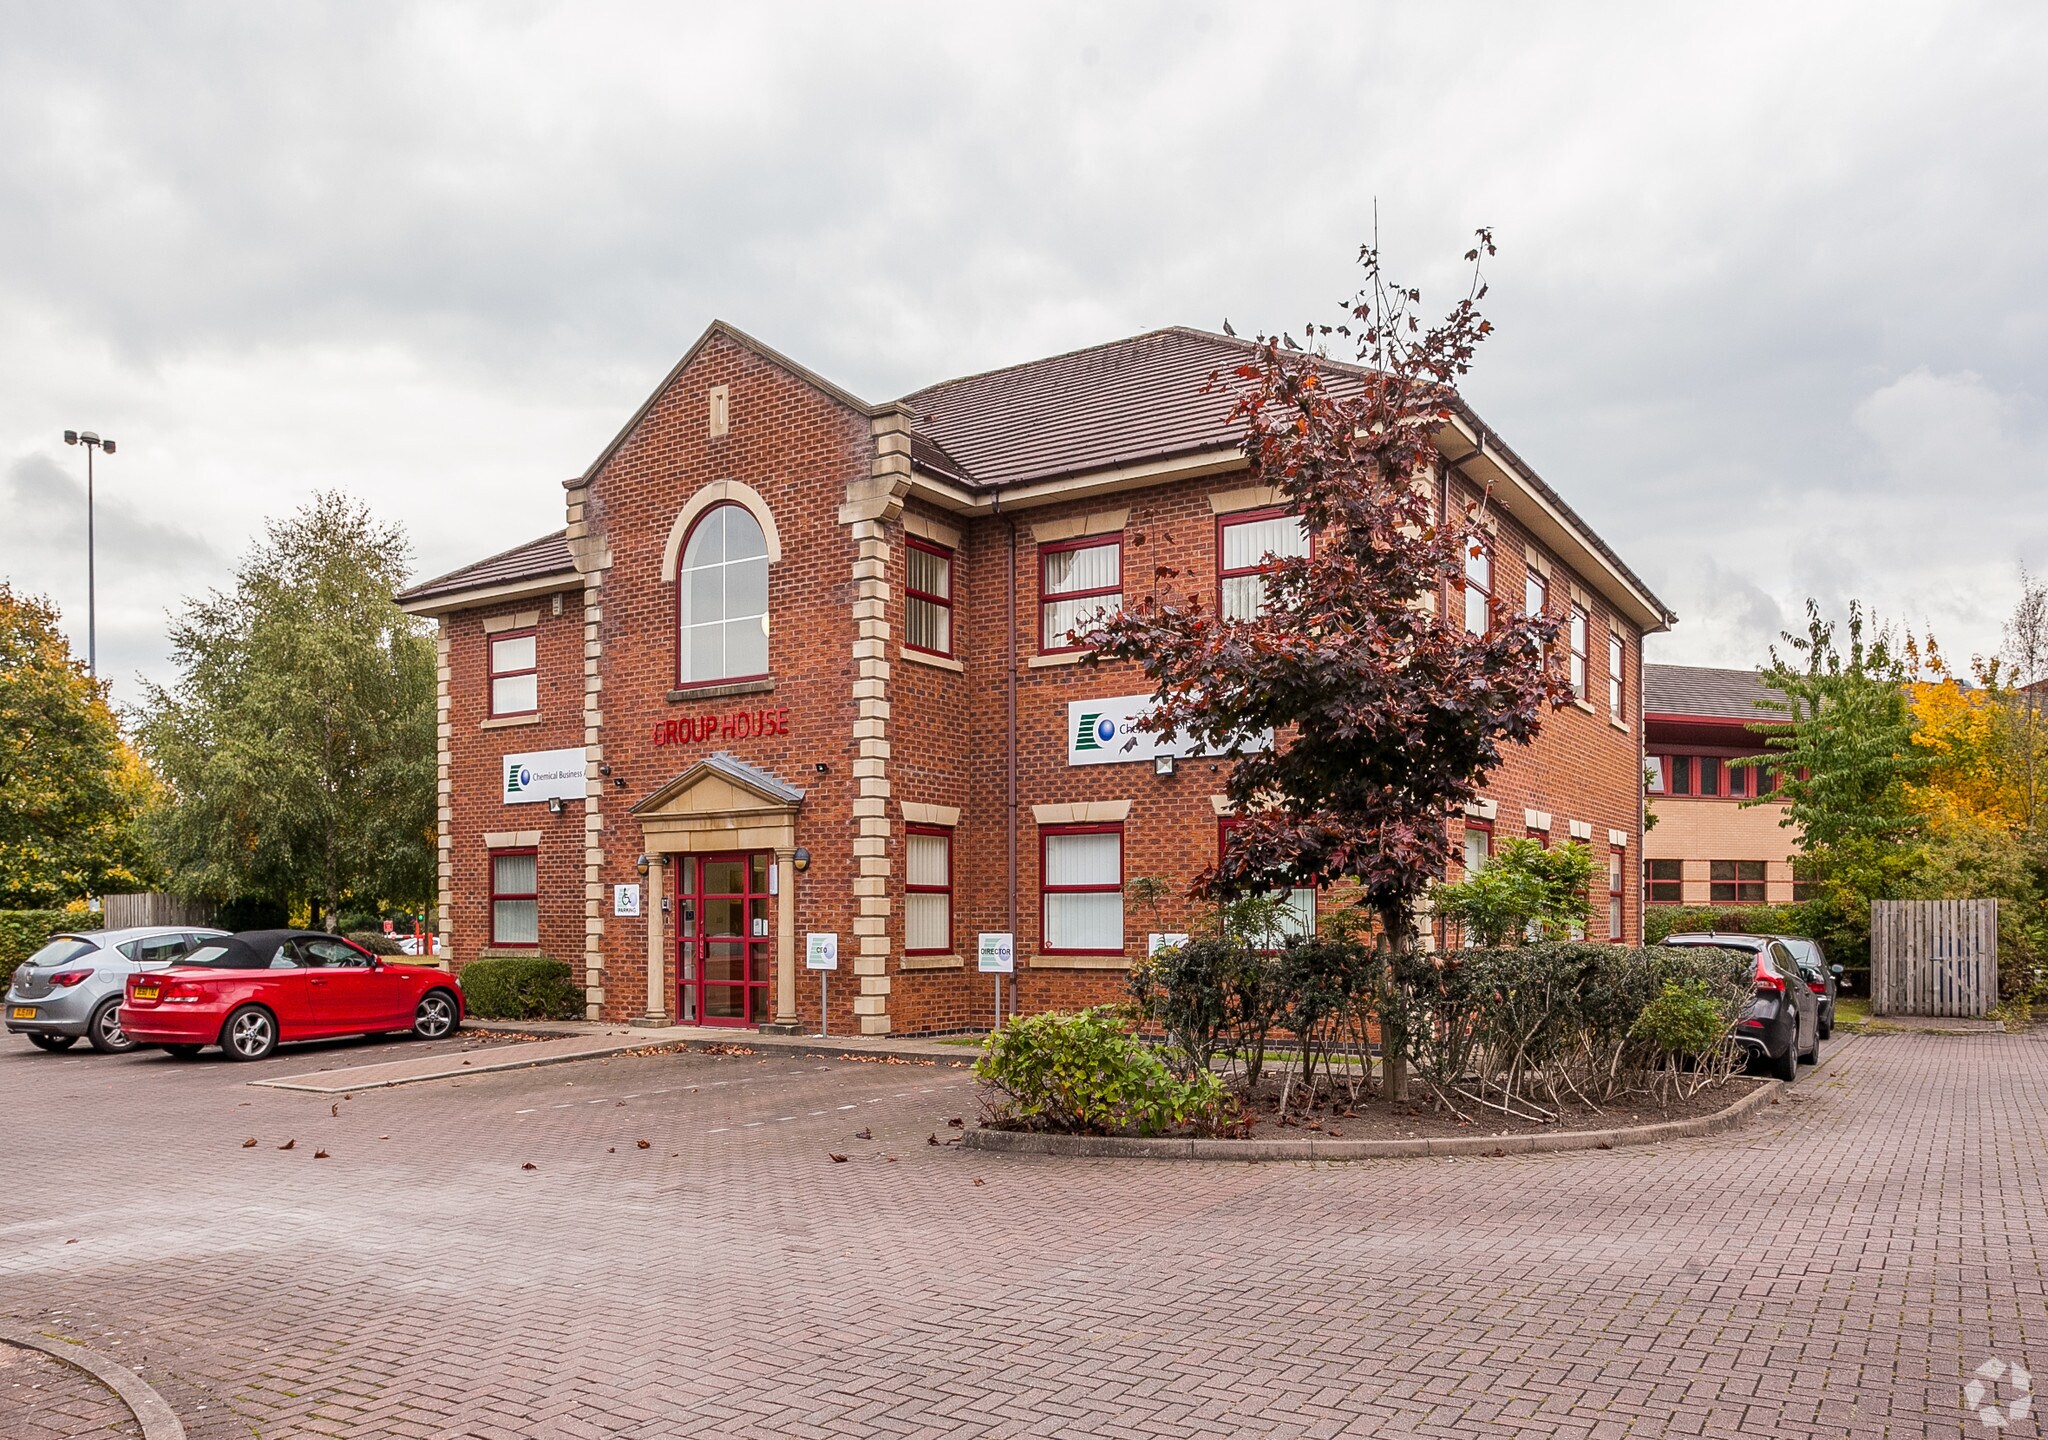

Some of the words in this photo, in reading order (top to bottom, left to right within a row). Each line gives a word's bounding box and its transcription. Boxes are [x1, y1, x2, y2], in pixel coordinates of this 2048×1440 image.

[653, 715, 717, 745] GROUP
[721, 707, 789, 739] HOUSE
[532, 771, 558, 782] Chemical
[559, 769, 583, 780] Business
[980, 948, 1012, 956] DIRECTOR
